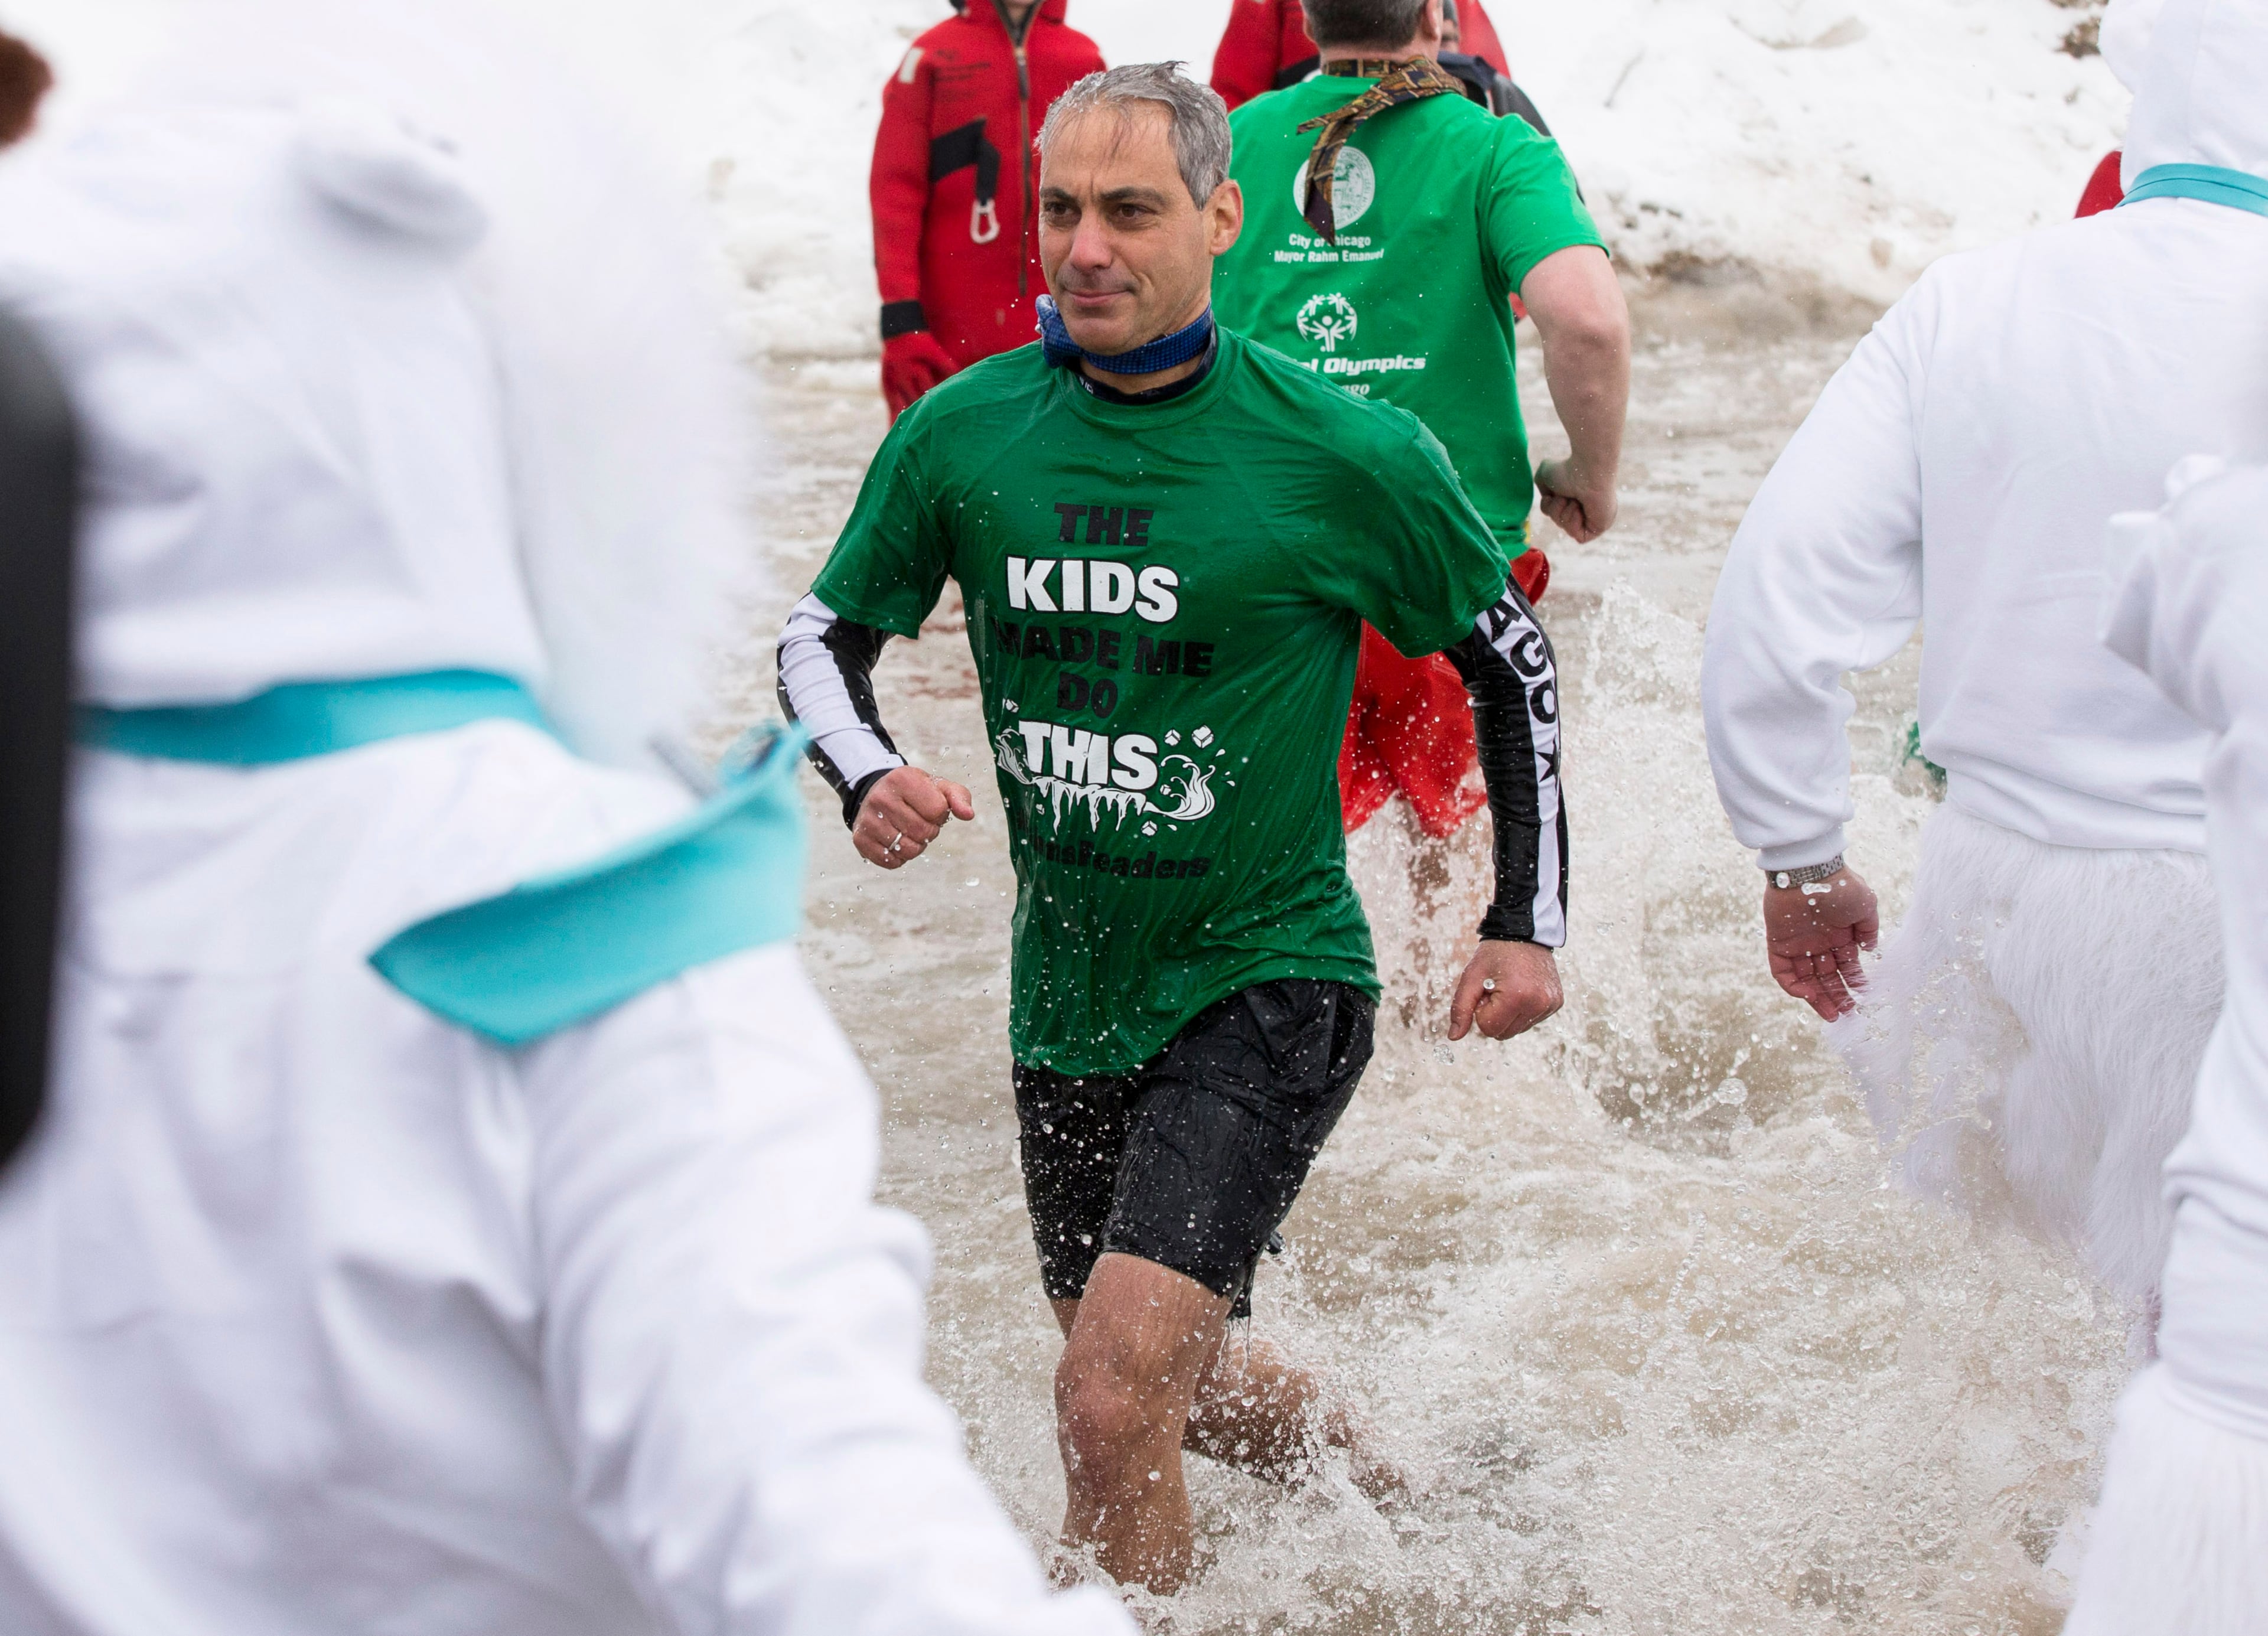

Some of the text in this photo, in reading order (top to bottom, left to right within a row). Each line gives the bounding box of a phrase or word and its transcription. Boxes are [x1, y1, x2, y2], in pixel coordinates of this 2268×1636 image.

[1274, 248, 1384, 263] Mayor Rahm Emanuel
[1288, 233, 1311, 249] City
[1328, 234, 1371, 248] hicago
[1323, 354, 1426, 376] Olympics
[1054, 501, 1154, 547] THE
[1005, 554, 1181, 624] KIDS
[990, 615, 1214, 677] MADE ME
[1057, 672, 1118, 718] DO
[1018, 719, 1159, 791] THIS
